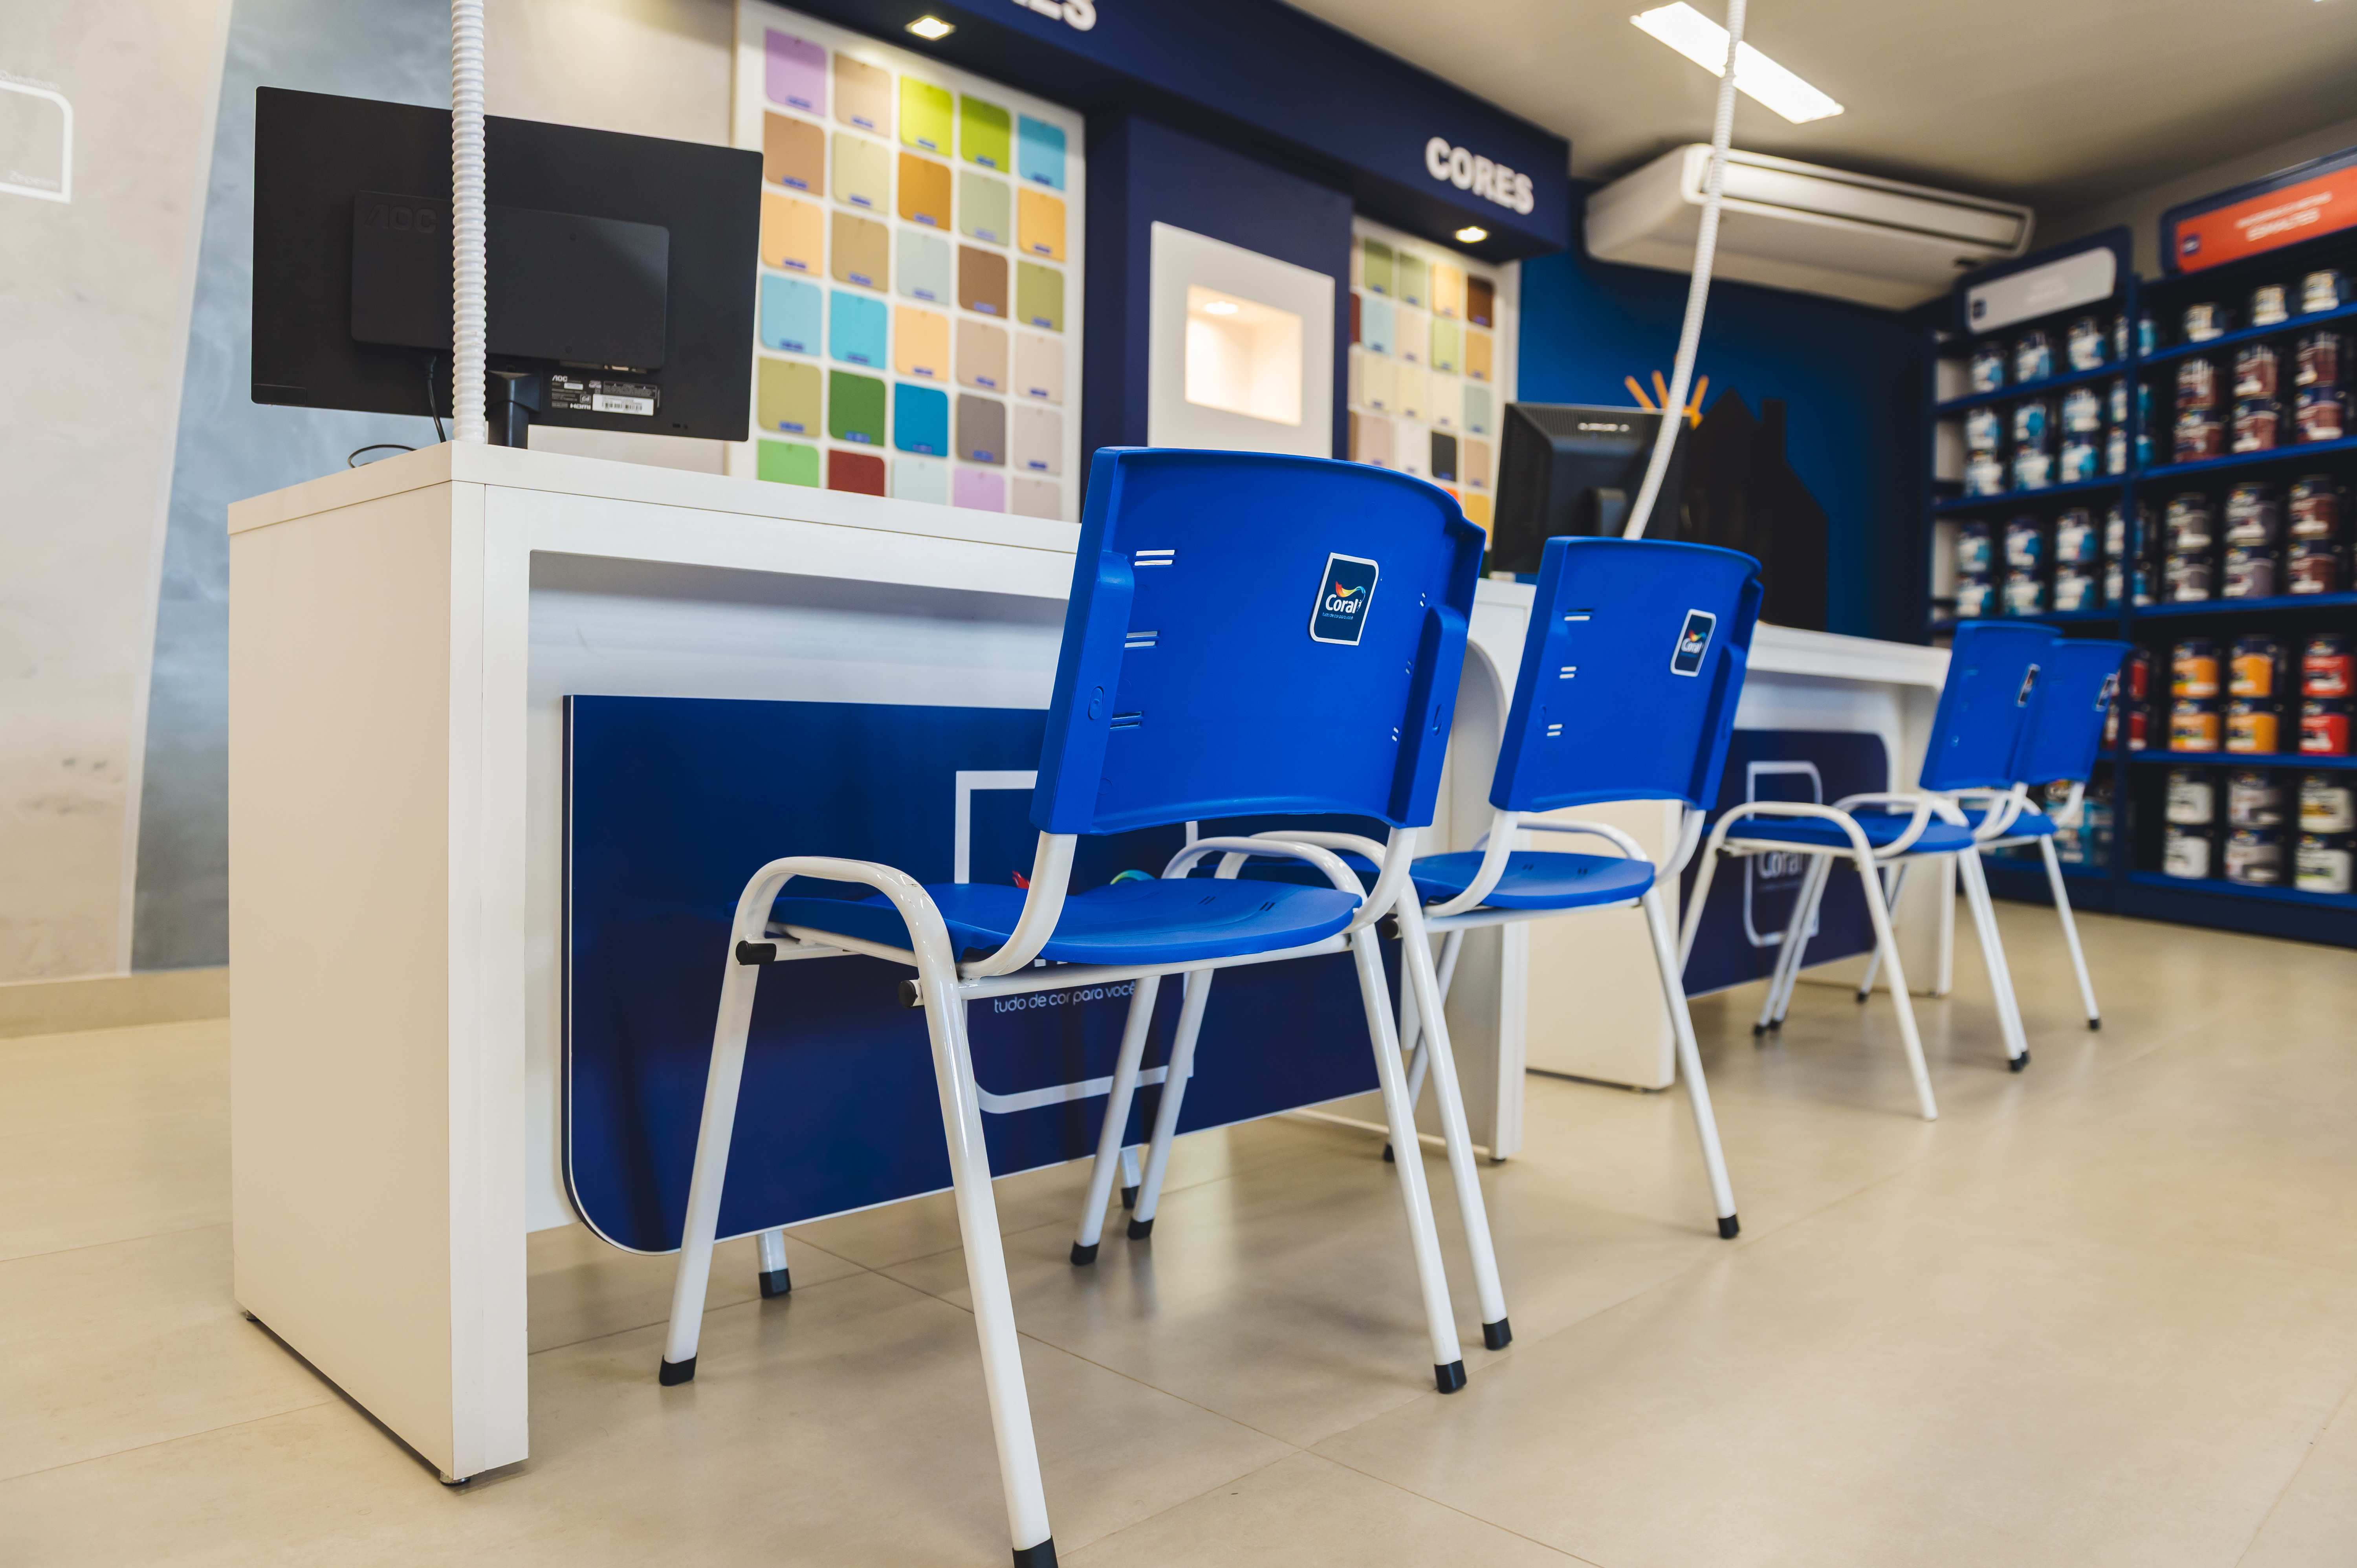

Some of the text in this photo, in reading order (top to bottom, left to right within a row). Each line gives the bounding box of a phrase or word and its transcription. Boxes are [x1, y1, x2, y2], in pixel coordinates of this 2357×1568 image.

[1425, 136, 1534, 215] CORES
[364, 203, 437, 233] AOC
[1325, 594, 1358, 614] Coral
[1681, 638, 1702, 653] Coral
[994, 981, 1135, 1013] tudo de cor para você
